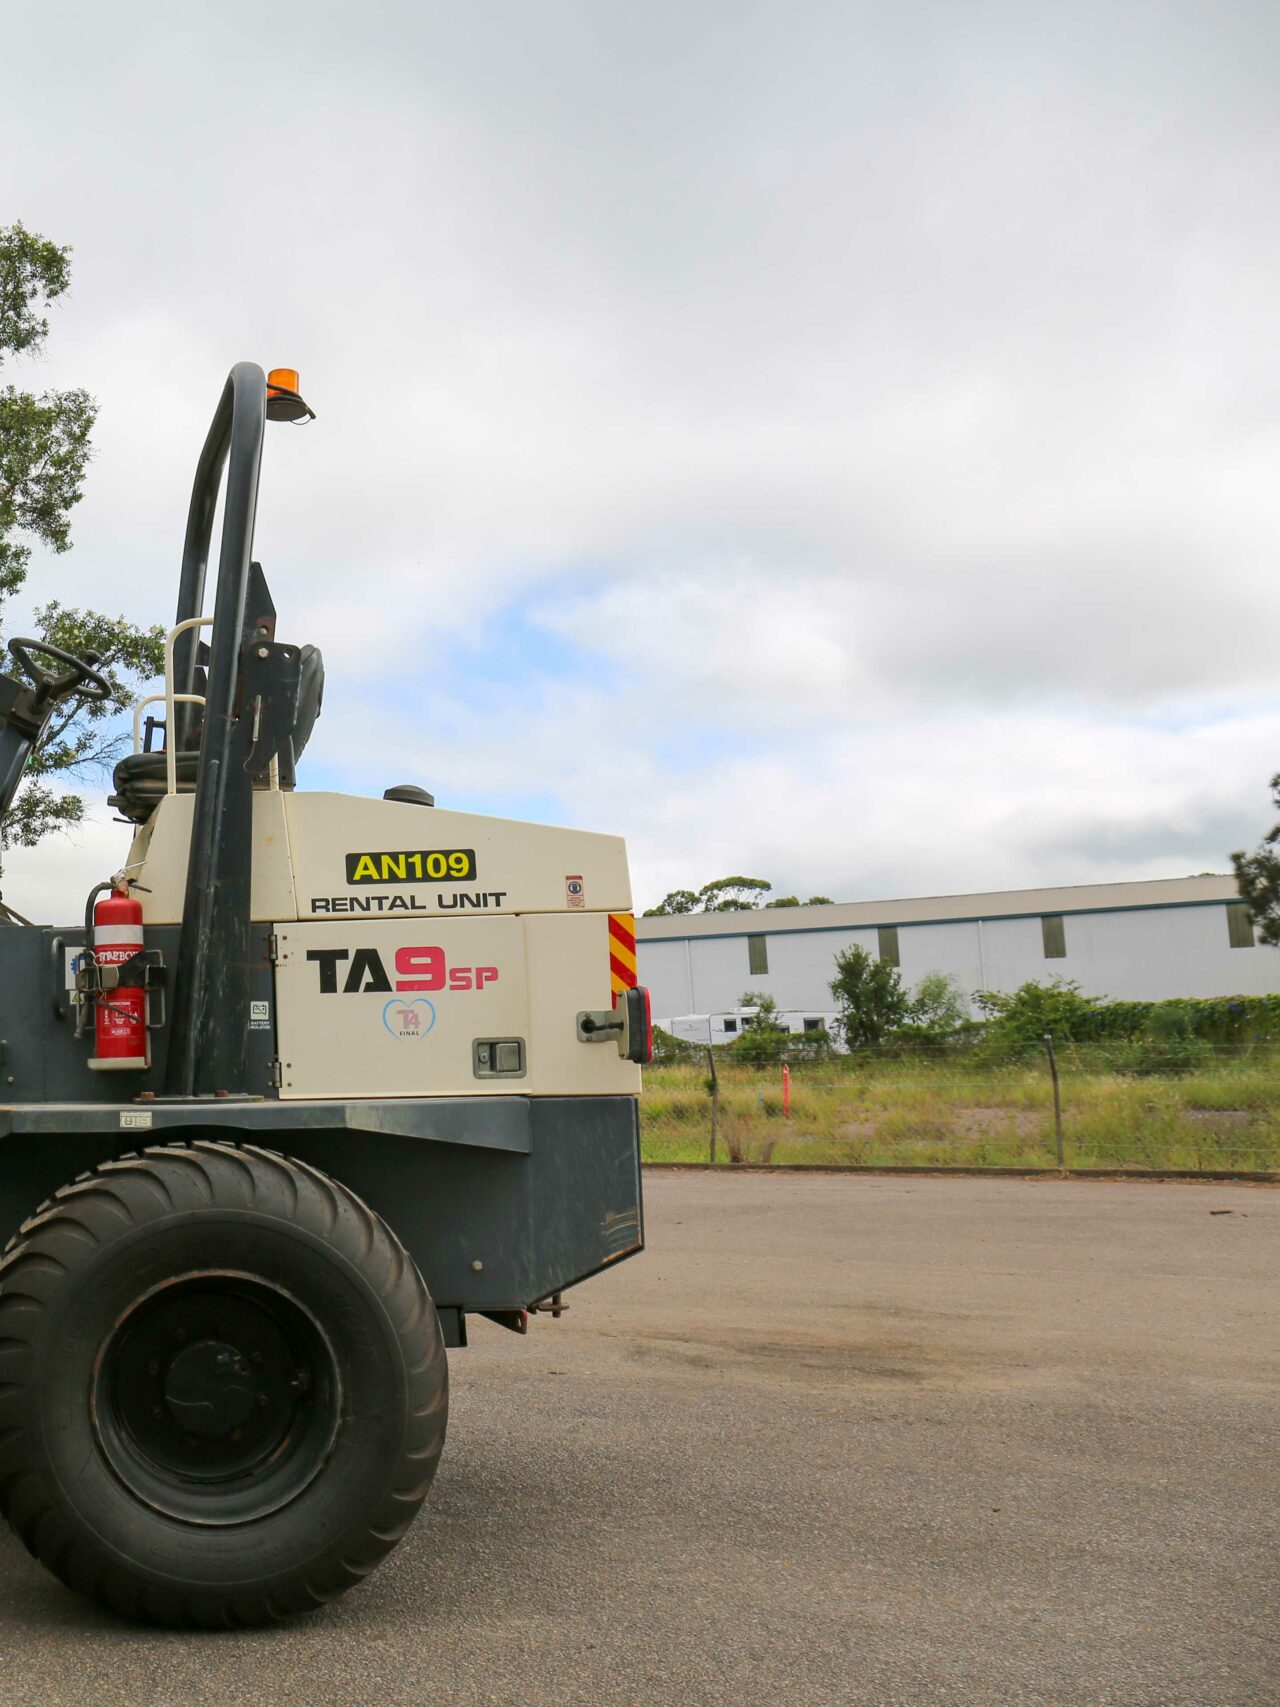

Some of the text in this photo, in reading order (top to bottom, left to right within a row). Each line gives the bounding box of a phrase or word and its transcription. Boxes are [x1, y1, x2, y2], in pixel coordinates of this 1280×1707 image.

[353, 852, 470, 881] AN109
[311, 892, 507, 913] RENTAL UNIT
